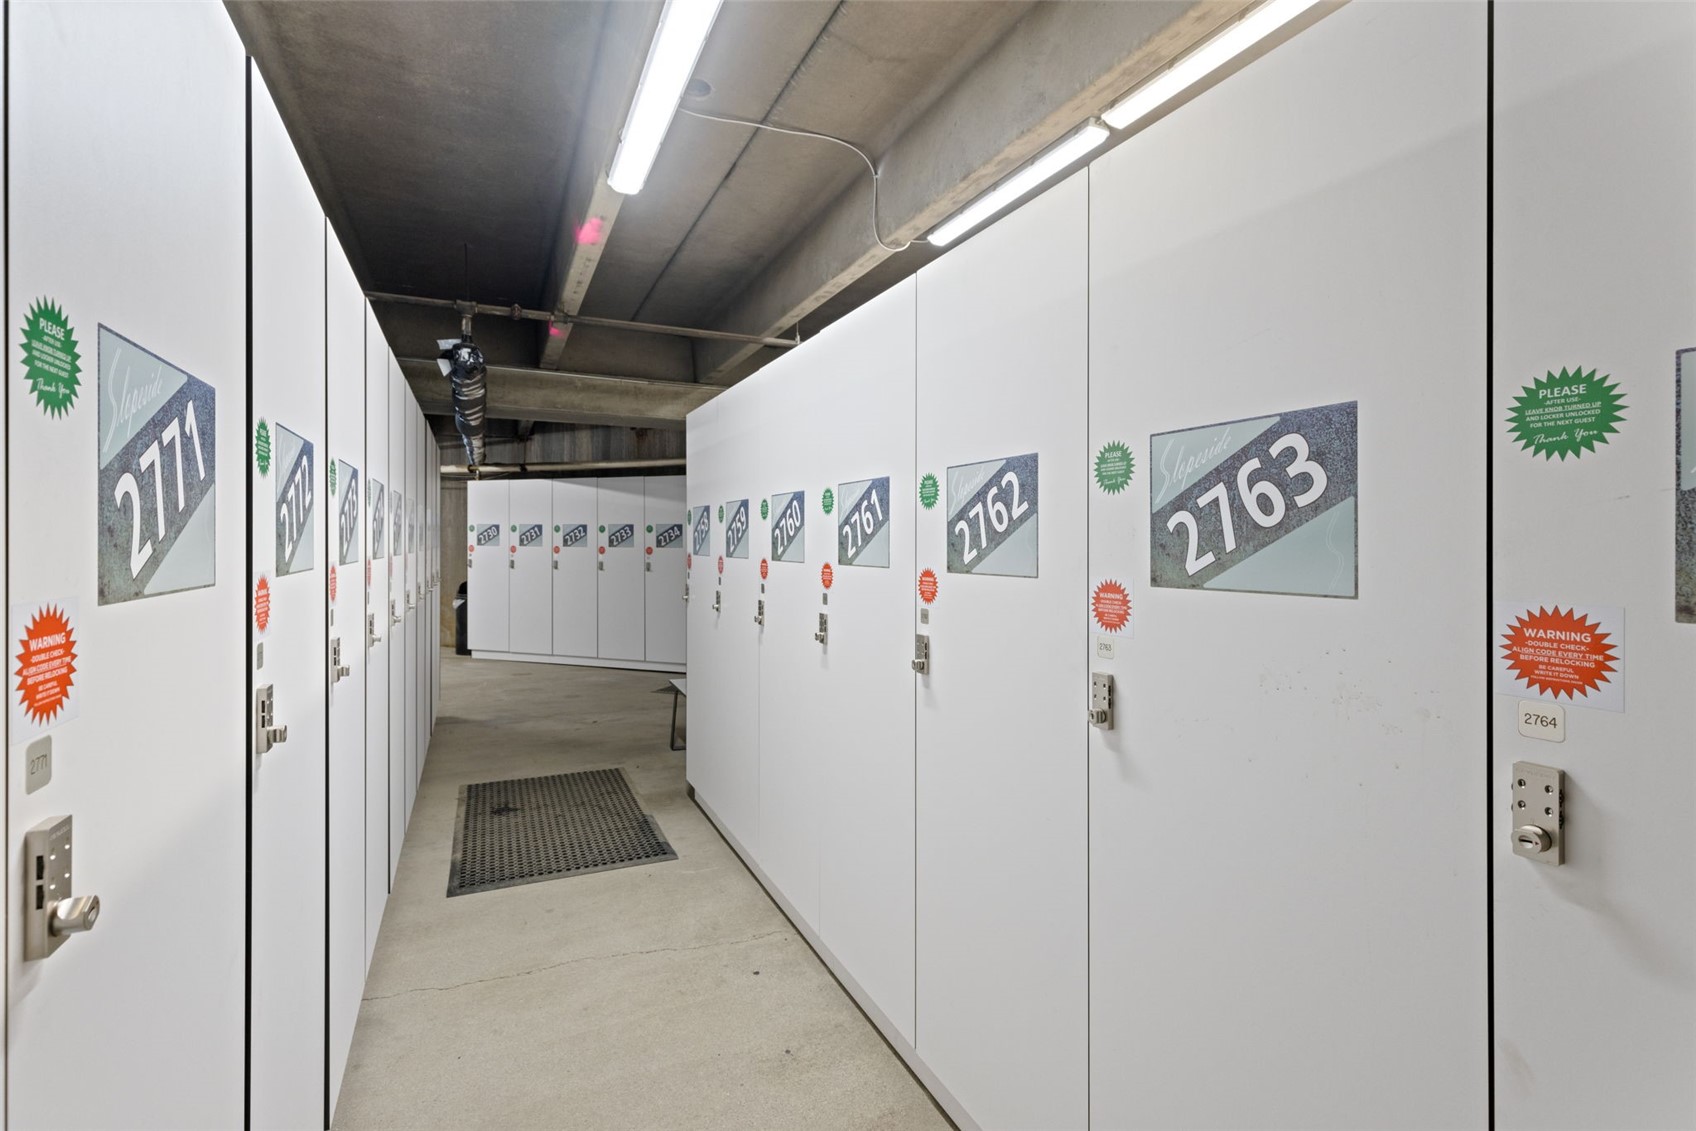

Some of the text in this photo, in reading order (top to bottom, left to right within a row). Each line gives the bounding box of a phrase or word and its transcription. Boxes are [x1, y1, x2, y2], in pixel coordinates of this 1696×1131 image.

[39, 317, 65, 340] PLEASE
[36, 377, 70, 399] Thank You
[1539, 383, 1587, 399] PLEASE
[1545, 406, 1563, 414] KNOB
[1564, 403, 1591, 411] TURNED
[1565, 408, 1601, 417] UNLOCKED
[1574, 416, 1596, 424] GUEST
[1533, 427, 1598, 444] Thank You
[1105, 450, 1122, 460] PLEASE
[114, 399, 206, 580] 2771
[280, 454, 312, 563] 2772
[1166, 432, 1328, 577] 2763
[340, 478, 356, 556] 2773
[843, 488, 883, 559] 2761
[955, 471, 1029, 565] 2762
[479, 526, 498, 544] 2730
[521, 526, 541, 545] 2731
[564, 526, 586, 545] 2732
[610, 526, 632, 546] 2733
[658, 526, 680, 546] 2734
[694, 511, 708, 551] 2758
[728, 506, 746, 553] 2759
[774, 500, 801, 556] 2760
[1099, 592, 1123, 600] WARNING
[29, 632, 66, 652] WARNING
[1523, 627, 1592, 643] WARNING
[1099, 642, 1112, 652] 2763
[1512, 646, 1604, 661] ALIGN CODE EVERY TIME
[1520, 654, 1595, 668] BEFORE RELOCKING
[1524, 712, 1557, 728] 2764
[30, 754, 47, 775] 2771
